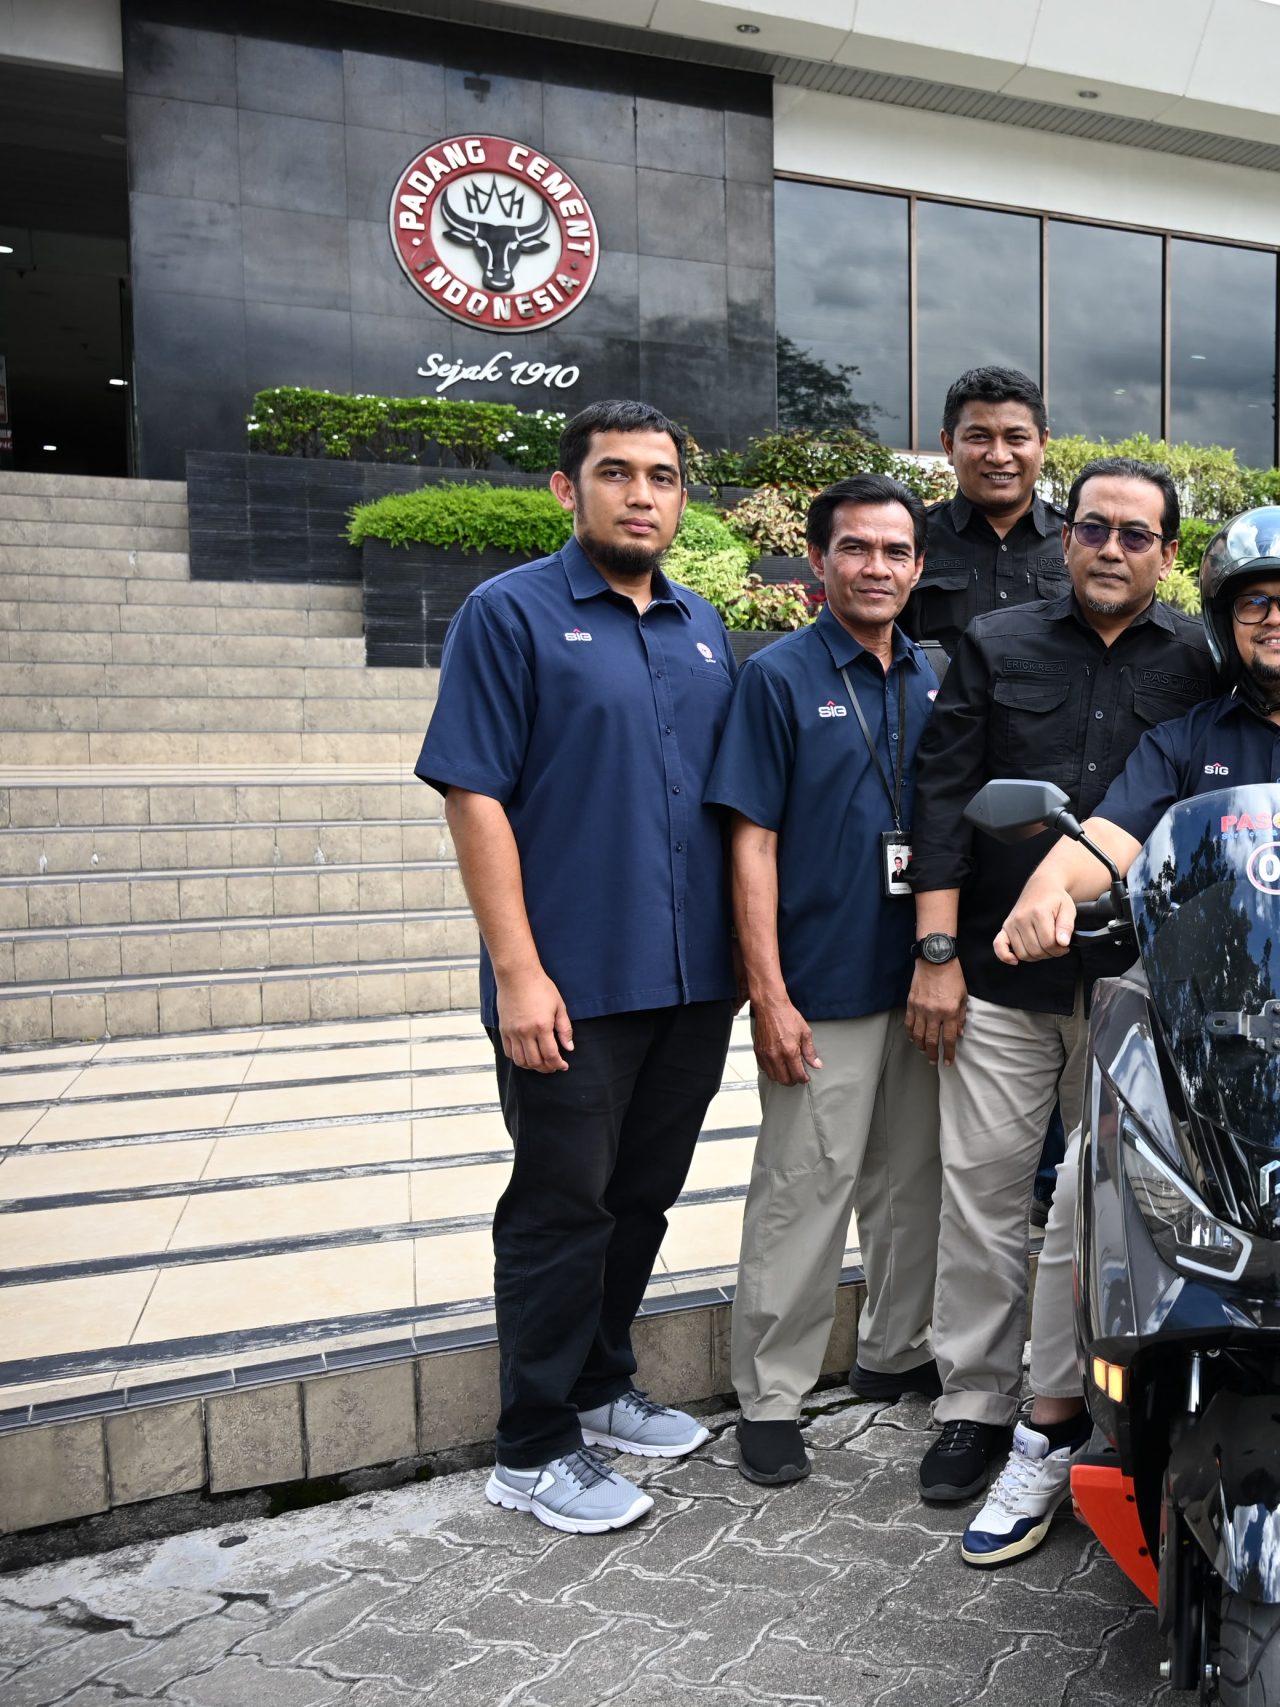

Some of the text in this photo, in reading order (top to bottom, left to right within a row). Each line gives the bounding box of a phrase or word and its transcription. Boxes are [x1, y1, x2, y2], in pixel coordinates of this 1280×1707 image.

[399, 140, 591, 257] PADANG CEMENT
[415, 257, 580, 321] INDONESIA
[417, 351, 580, 393] Sejak 1910
[818, 704, 848, 718] SIG
[1204, 763, 1229, 776] SIG
